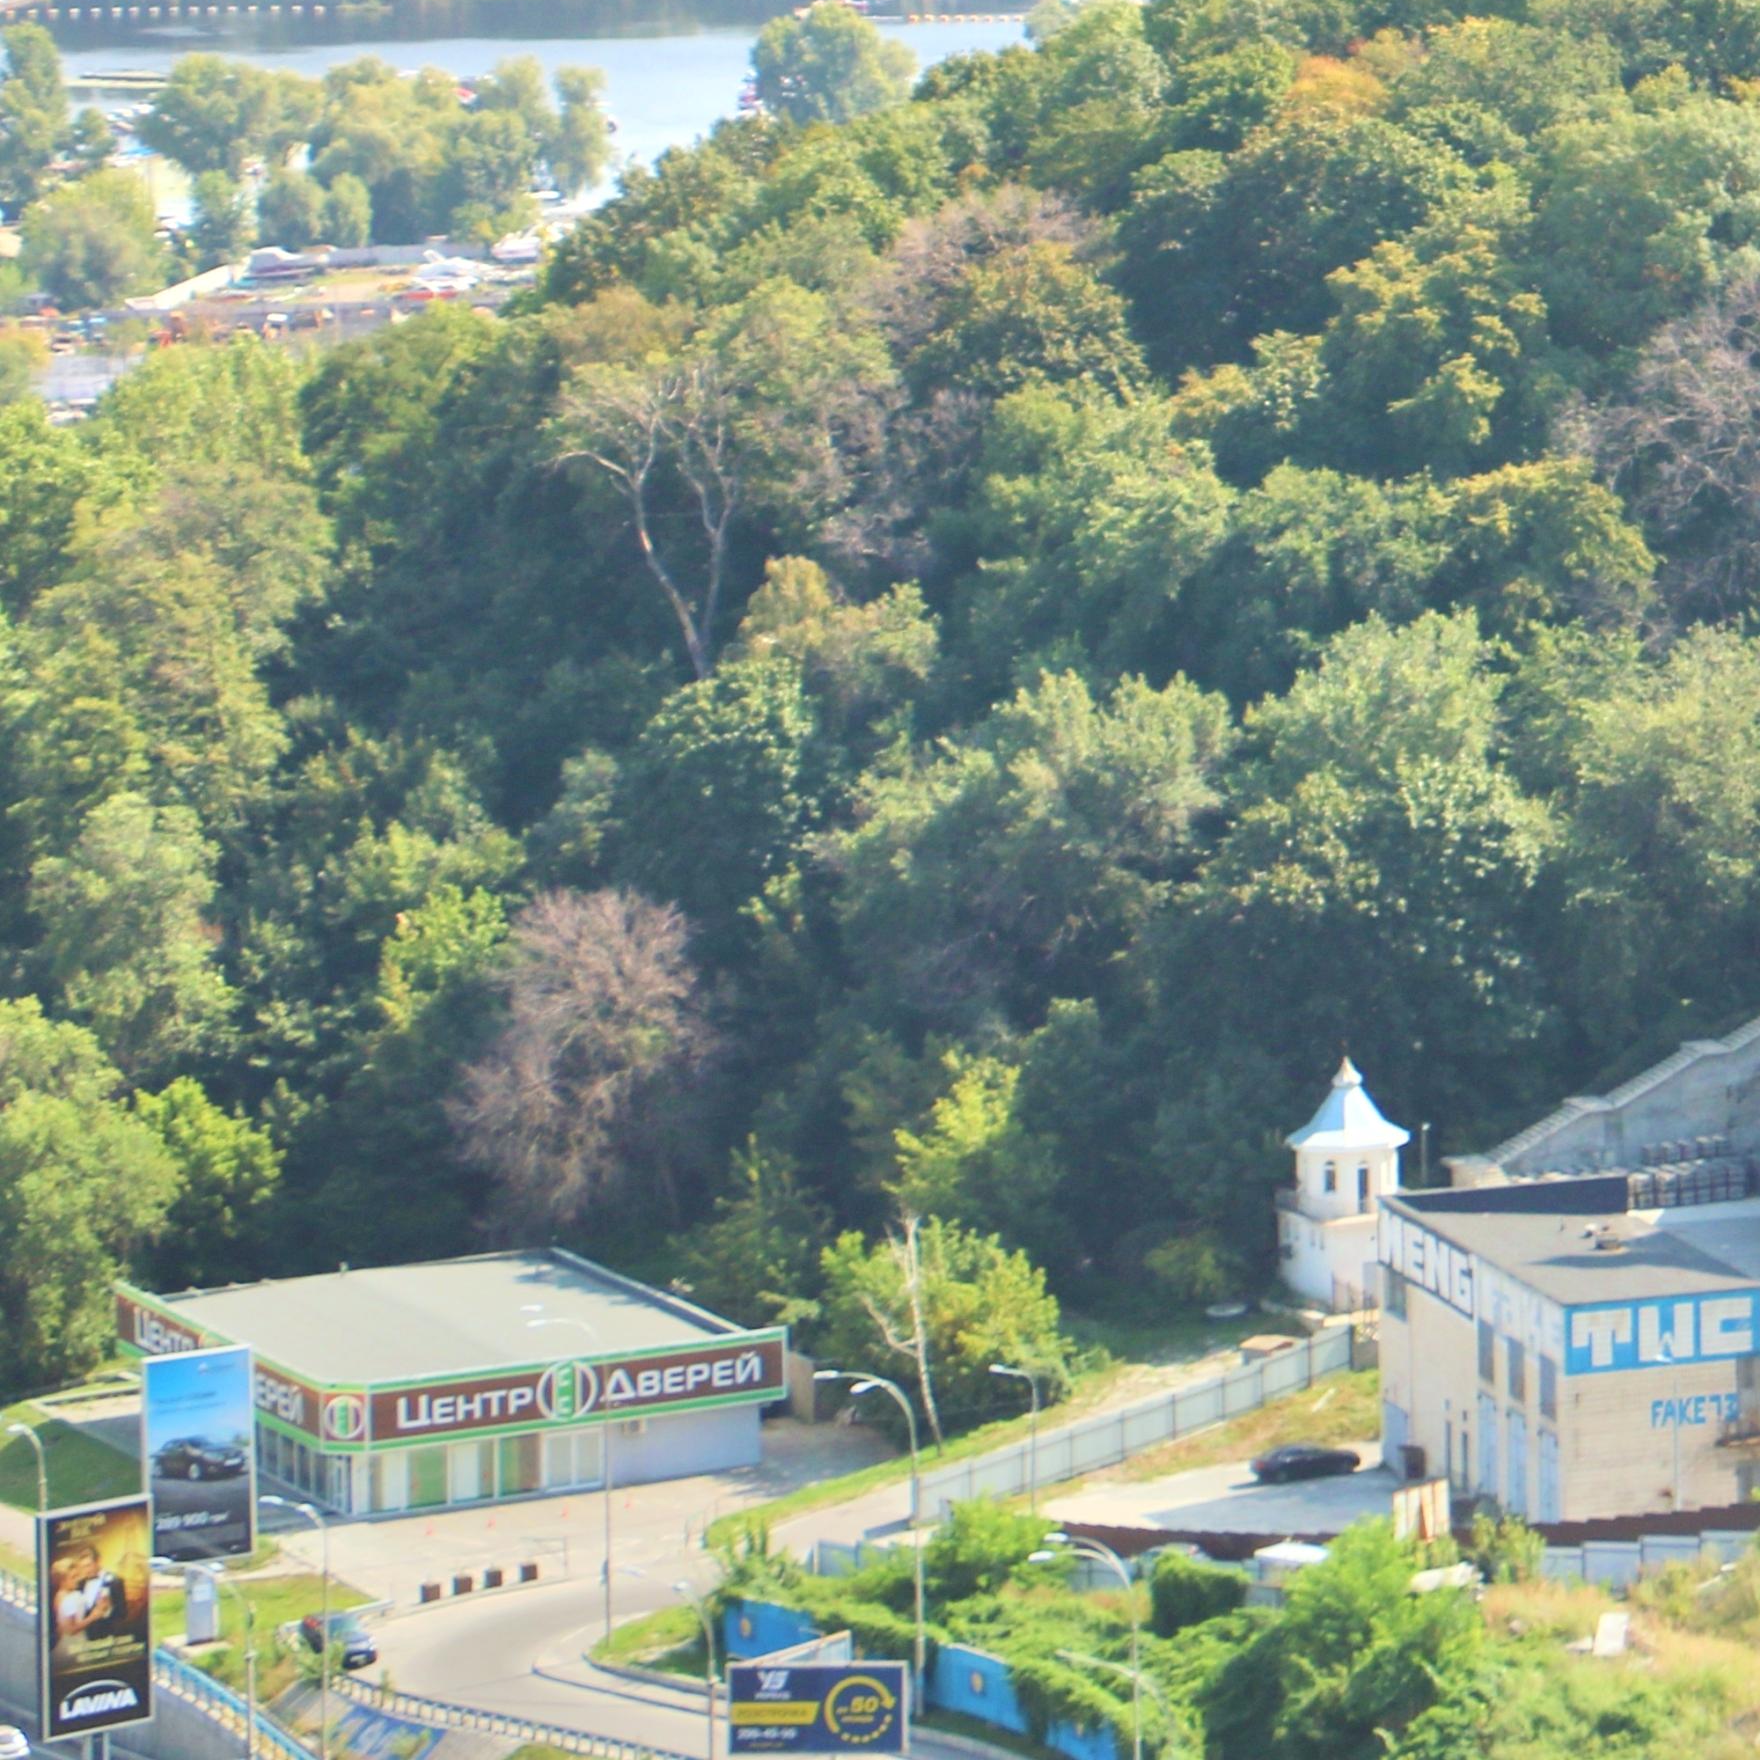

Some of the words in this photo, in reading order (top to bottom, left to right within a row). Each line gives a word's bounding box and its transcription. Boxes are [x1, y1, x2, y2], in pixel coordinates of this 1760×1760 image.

[396, 1386, 532, 1430] ЦЕНТР
[599, 1351, 762, 1403] ДВЕРЕЙ
[59, 1687, 137, 1721] LAVINA
